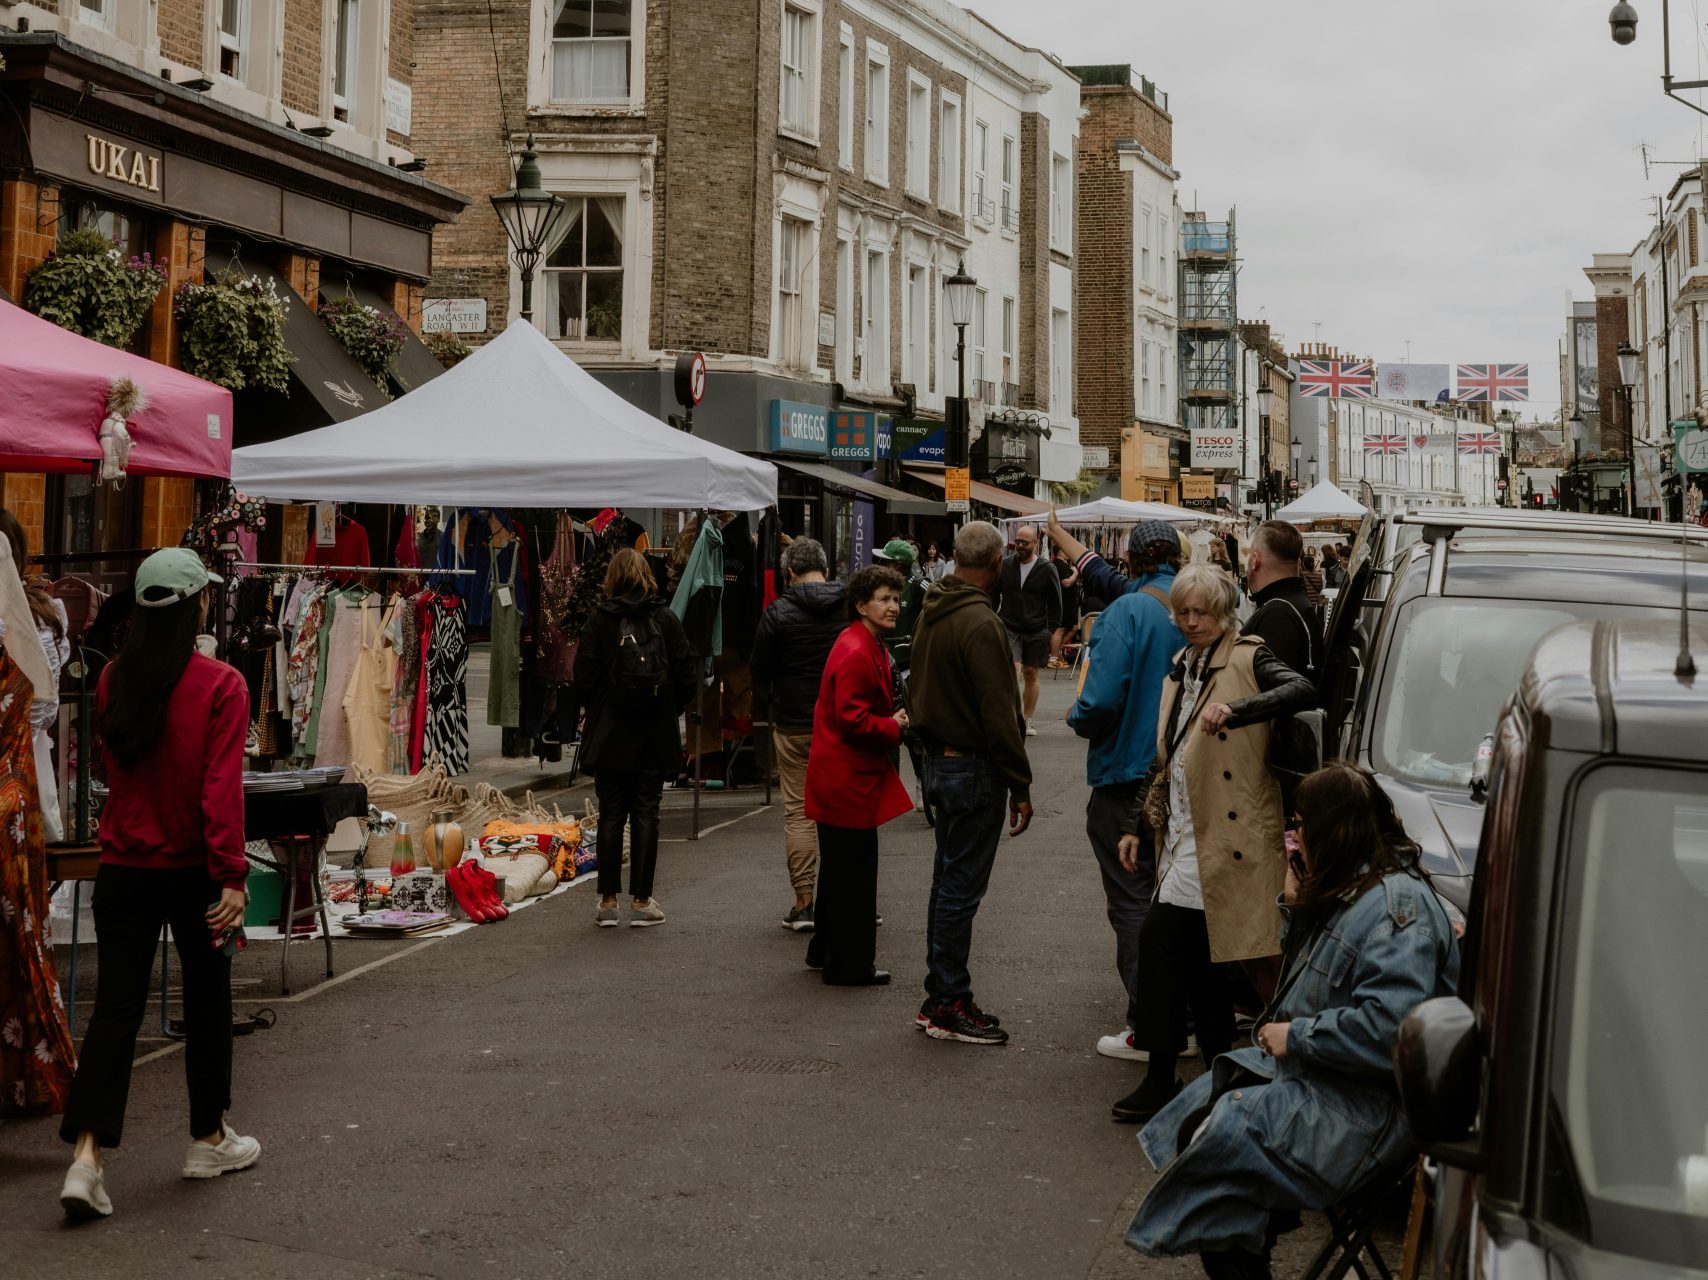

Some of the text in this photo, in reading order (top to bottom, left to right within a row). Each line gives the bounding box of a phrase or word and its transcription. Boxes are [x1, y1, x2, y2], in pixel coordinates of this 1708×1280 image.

[86, 134, 160, 192] UKAI
[427, 313, 481, 322] LANCASTER
[427, 322, 451, 330] ROAD
[791, 412, 825, 442] GREGGS
[896, 426, 928, 436] cannacy
[1196, 437, 1233, 445] TESCO
[831, 447, 870, 457] GREGGS
[1196, 450, 1233, 459] express
